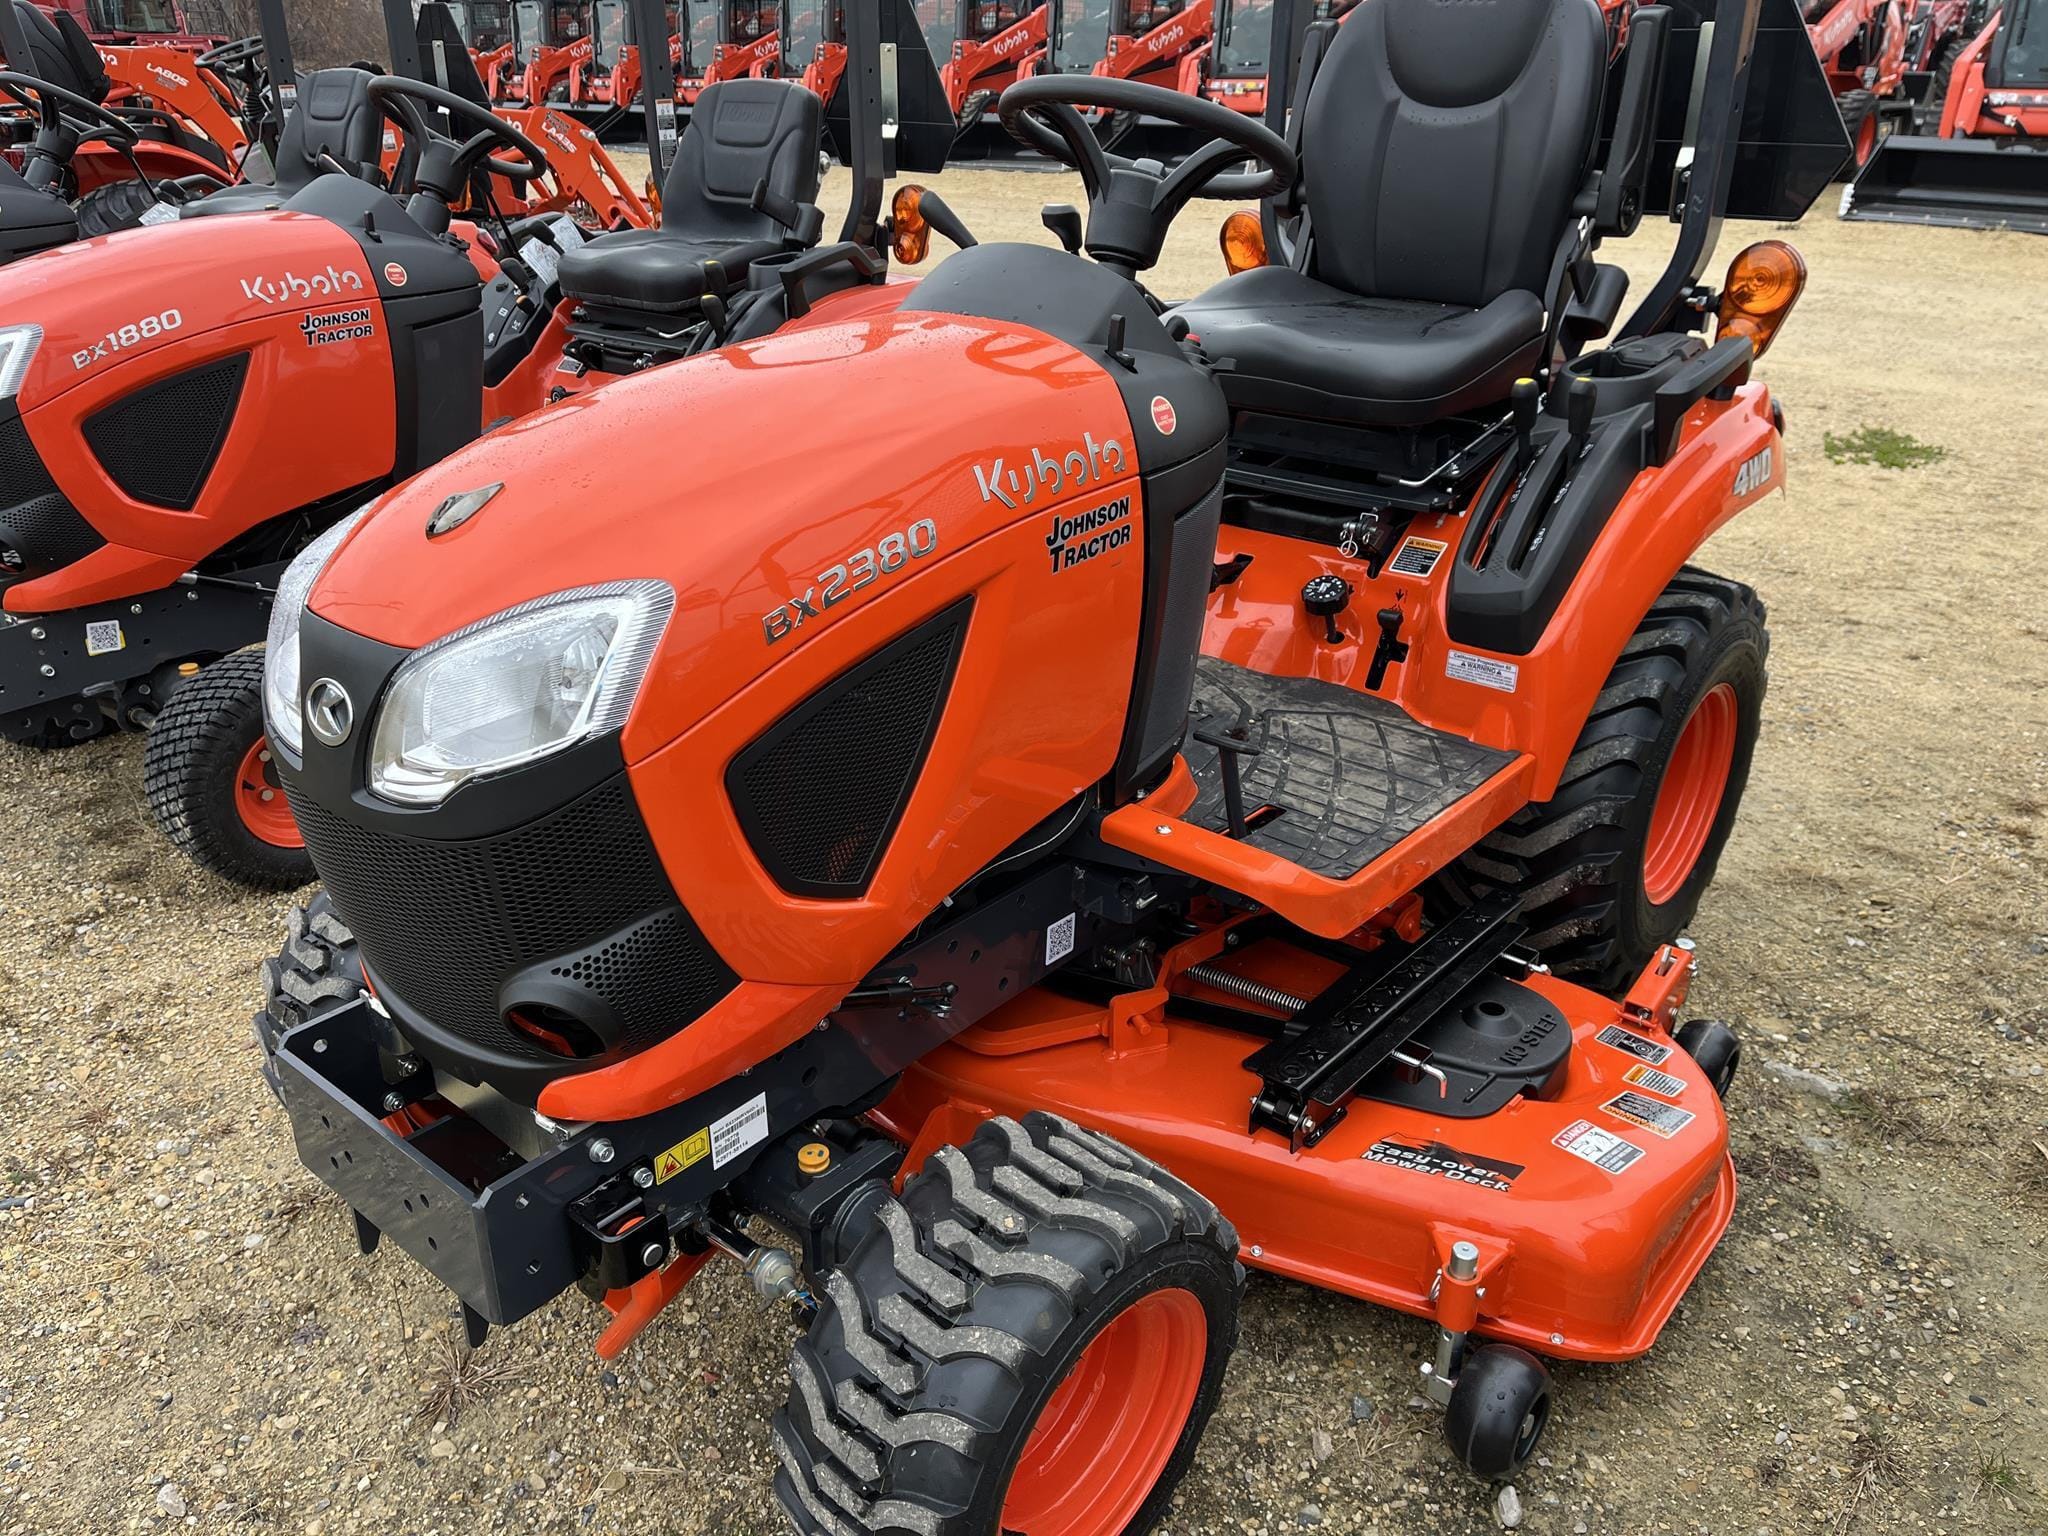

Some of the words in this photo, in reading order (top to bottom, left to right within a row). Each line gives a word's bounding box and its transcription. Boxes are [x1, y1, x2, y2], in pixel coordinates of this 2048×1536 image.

[570, 43, 593, 57] Kub
[754, 40, 780, 57] Kubo
[993, 30, 1029, 55] Kubota
[1148, 25, 1184, 51] Kubota
[240, 265, 364, 304] Kubota
[72, 309, 182, 370] BX1880
[300, 308, 370, 331] JOHNSON
[304, 325, 373, 347] TRACTOR
[972, 432, 1126, 508] Kubota
[1733, 446, 1771, 497] 4WD
[1046, 496, 1130, 547] JOHNSON
[1049, 524, 1131, 574] TRACTOR
[761, 517, 938, 645] BX2380
[1499, 1045, 1528, 1066] NO
[1520, 1013, 1557, 1048] STEP
[1361, 1150, 1443, 1176] Mower
[1444, 1170, 1511, 1192] Deck
[1368, 1142, 1501, 1178] Easy-over
